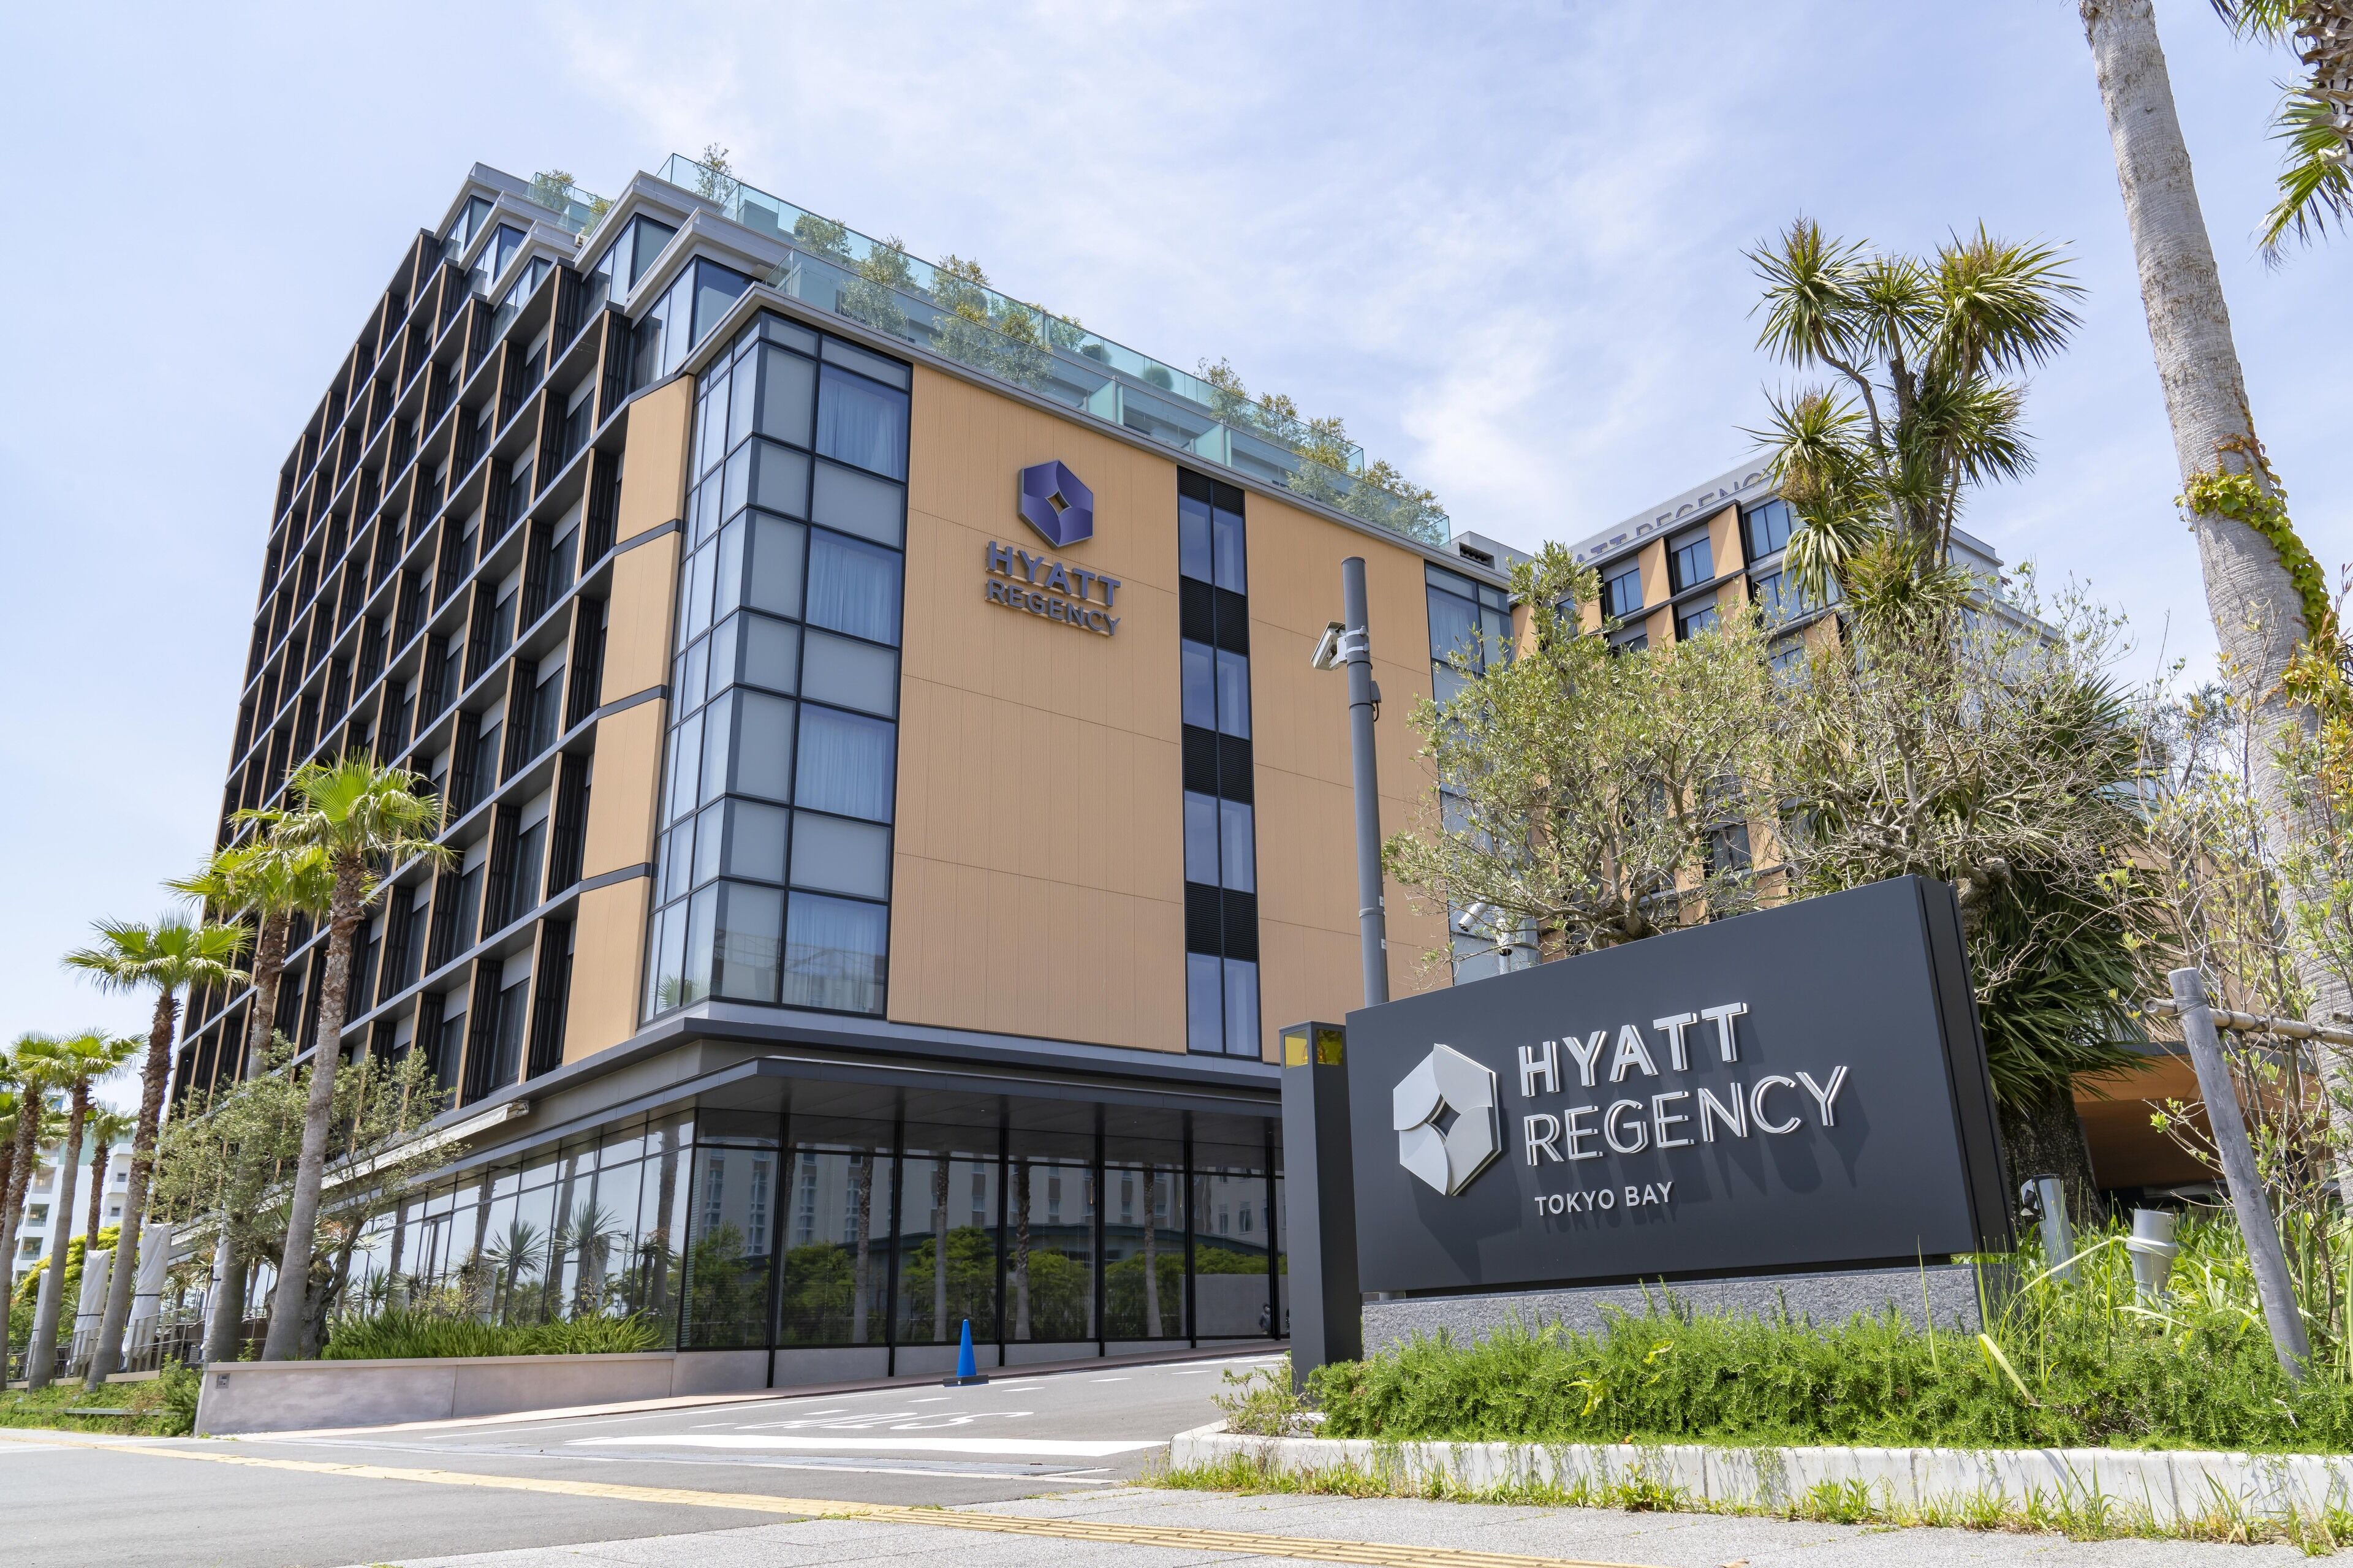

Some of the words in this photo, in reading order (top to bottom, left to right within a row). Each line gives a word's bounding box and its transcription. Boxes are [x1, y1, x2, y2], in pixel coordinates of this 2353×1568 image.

[987, 540, 1121, 607] HYATT
[987, 578, 1121, 636] REGENCY
[1518, 1002, 1748, 1097] HYATT
[1523, 1066, 1848, 1165] REGENCY
[1534, 1189, 1615, 1216] TOKYO
[1625, 1181, 1672, 1206] BAY
[733, 1412, 1034, 1430] STOP
